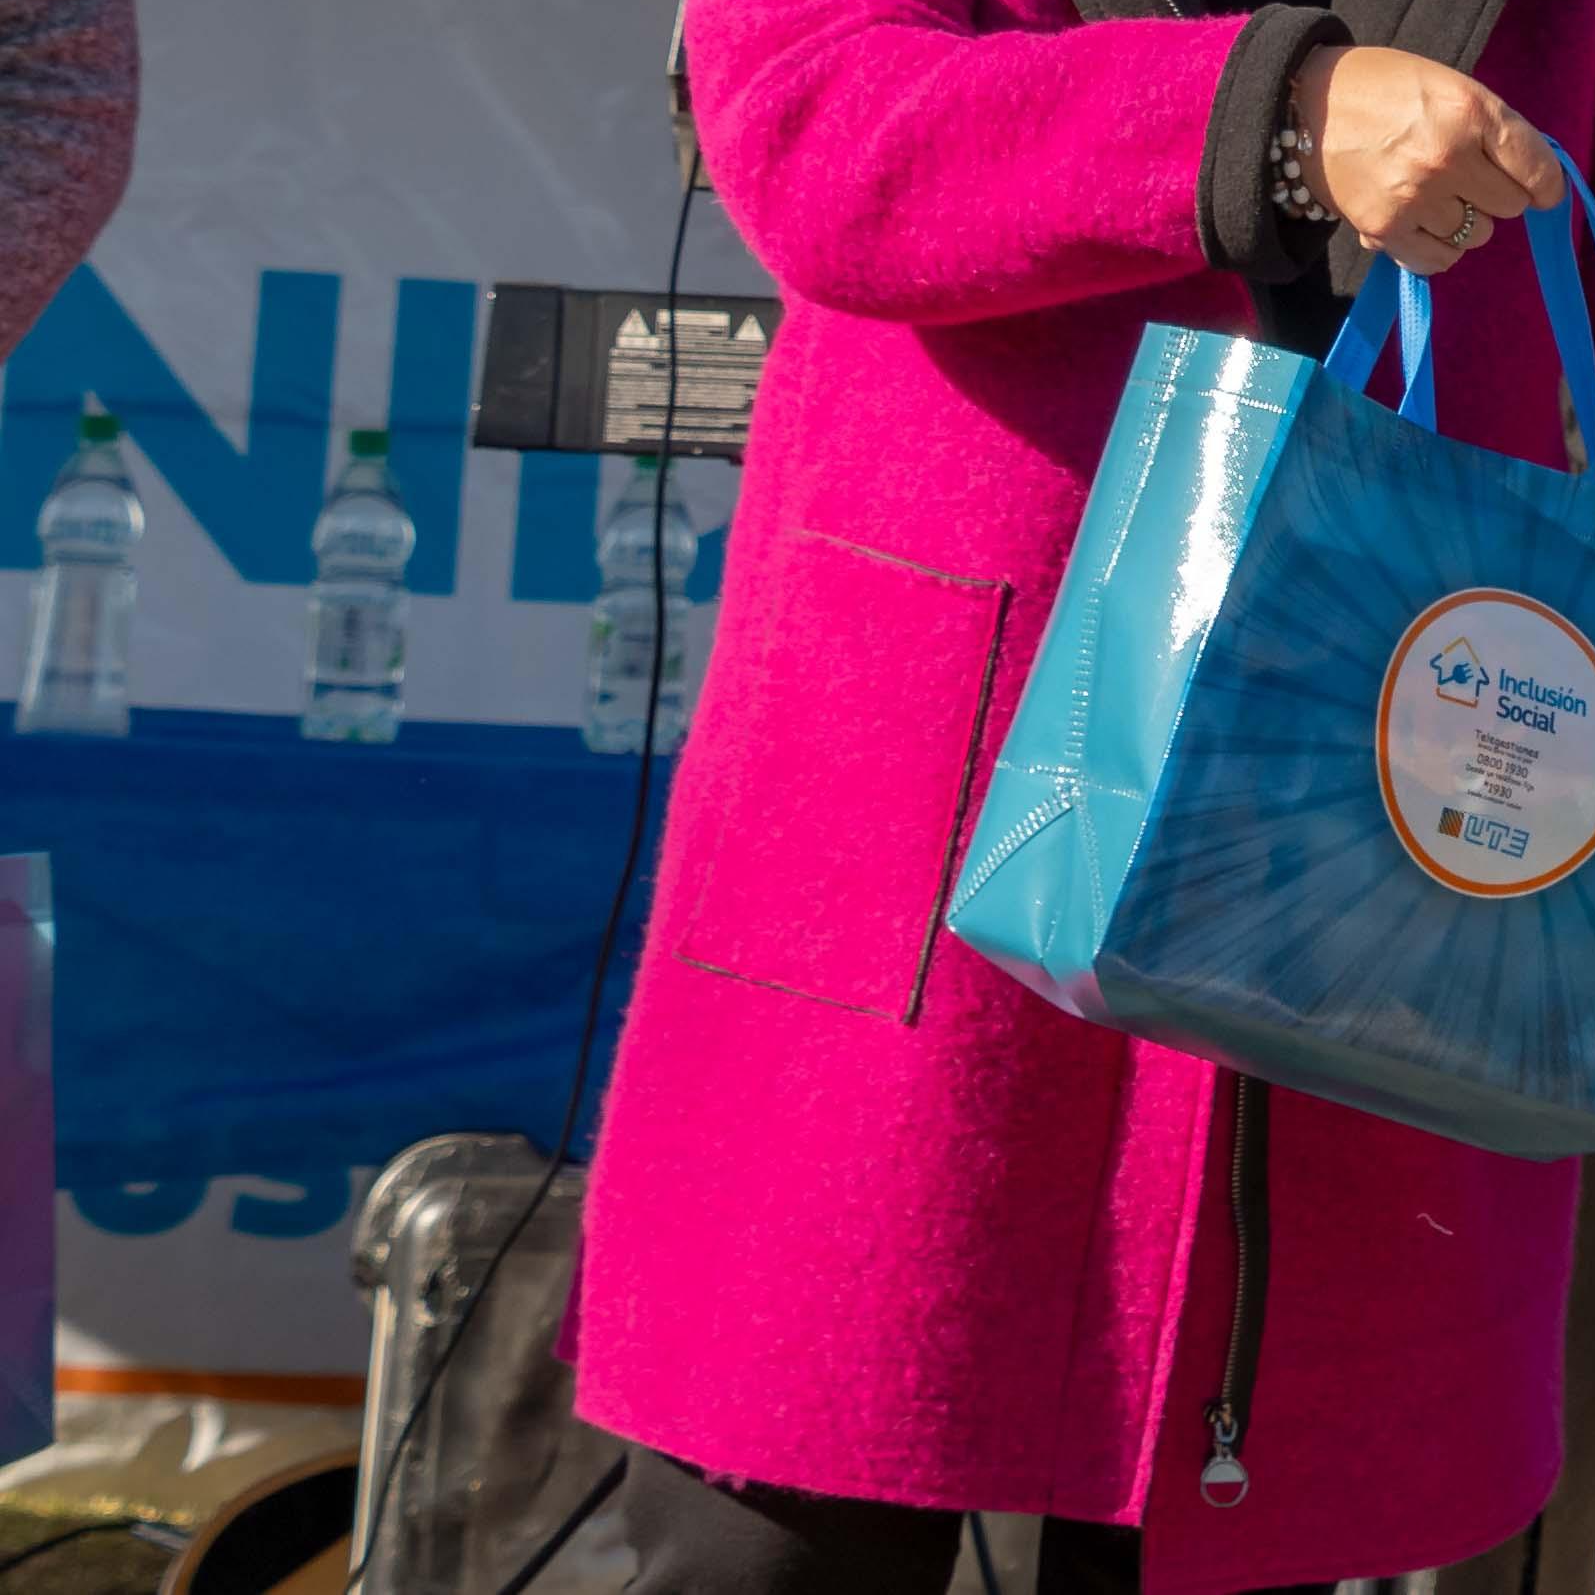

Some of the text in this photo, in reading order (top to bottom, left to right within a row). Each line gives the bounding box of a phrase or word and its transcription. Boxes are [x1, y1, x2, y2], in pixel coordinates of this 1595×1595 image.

[1499, 668, 1587, 718] Inclusión
[1496, 695, 1557, 735] Social
[1476, 753, 1503, 771] 0800
[1505, 762, 1529, 779] 1930
